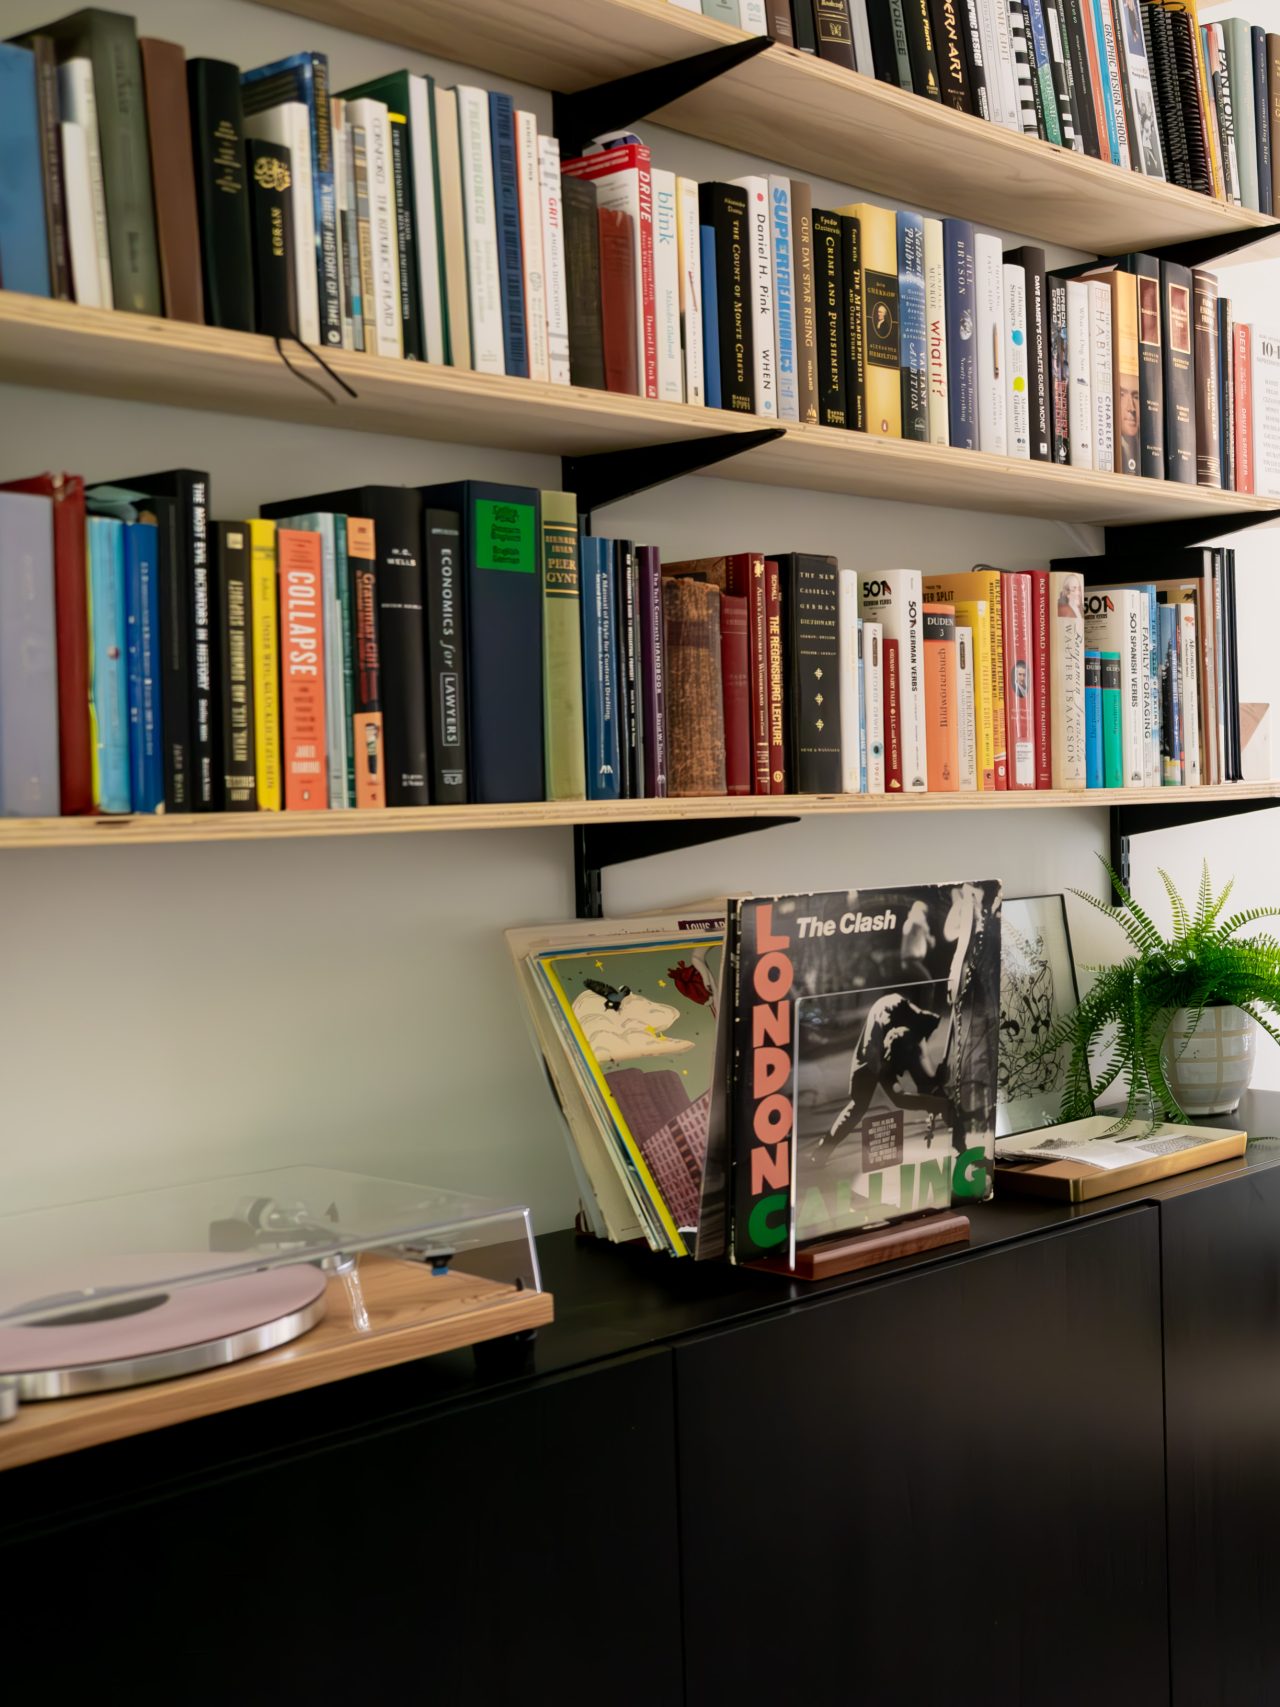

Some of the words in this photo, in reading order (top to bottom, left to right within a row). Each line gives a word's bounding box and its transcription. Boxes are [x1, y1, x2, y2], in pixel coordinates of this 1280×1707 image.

[922, 19, 932, 51] Plants
[970, 30, 983, 67] DESIGN
[1103, 23, 1117, 67] GRAPHIC
[948, 43, 962, 83] ART
[1110, 71, 1122, 107] DESIGN
[1217, 49, 1236, 147] PANTONE
[1115, 109, 1127, 147] SCHOOL
[322, 195, 336, 228] BRIEF
[547, 196, 559, 229] GRIT
[639, 170, 652, 223] DRIVE
[270, 207, 284, 256] KORAN
[657, 191, 674, 246] blink
[732, 220, 741, 240] THE
[756, 213, 768, 260] Daniel
[800, 216, 810, 243] OUR
[324, 230, 339, 280] HISTORY
[732, 243, 743, 281] COUNT
[758, 265, 769, 279] H.
[801, 247, 811, 269] DAY
[825, 236, 836, 279] CRIME
[956, 240, 967, 296] BRYSON
[965, 254, 974, 286] BILL
[327, 283, 338, 296] OF
[773, 187, 793, 373] SUPERFREAKONOMICS
[802, 273, 813, 303] STAR
[827, 281, 837, 306] AND
[853, 268, 862, 290] THE
[1034, 274, 1042, 296] DAVE
[327, 299, 340, 325] TIME
[759, 285, 770, 315] Pink
[645, 315, 655, 345] Daniel
[733, 301, 744, 340] MONTE
[803, 307, 814, 348] RISING
[854, 293, 864, 383] METAMORPHOSIS
[827, 311, 840, 392] PUNISHMENT
[929, 319, 944, 368] what
[1036, 334, 1044, 373] COMPLETE
[1094, 309, 1107, 369] HABIT
[647, 360, 656, 381] Pink
[735, 343, 745, 382] CRISTO
[761, 349, 772, 390] WHEN
[908, 342, 920, 411] AMBITION
[931, 372, 945, 398] if?
[1037, 374, 1045, 397] GUIDE
[1039, 406, 1047, 434] MONEY
[1096, 395, 1105, 446] DUHIGG
[1104, 395, 1112, 450] CHARLES
[192, 483, 206, 504] THE
[193, 506, 207, 539] MOST
[386, 558, 416, 567] WELLS
[546, 572, 578, 585] GYNT
[548, 558, 577, 570] PEER
[194, 568, 209, 626] DICTATORS
[440, 547, 454, 636] ECONOMICS
[770, 574, 778, 602] SCHALL
[863, 580, 892, 597] 501
[936, 590, 954, 602] SPLIT
[287, 570, 318, 677] COLLAPSE
[769, 615, 780, 634] THE
[800, 618, 836, 627] DICTIONARY
[908, 599, 917, 628] 501
[927, 617, 954, 626] DUDEN
[1129, 612, 1138, 634] 501
[196, 627, 209, 641] IN
[909, 629, 917, 664] GERMAN
[1142, 627, 1150, 670] FAMILY
[196, 643, 210, 690] HISTORY
[439, 640, 456, 669] for
[654, 642, 662, 695] HANDBOOK
[769, 635, 782, 701] REGENSBURG
[1064, 624, 1073, 681] WALTER
[1130, 635, 1138, 675] SPANISH
[910, 665, 918, 692] VERBS
[1131, 677, 1139, 708] VERBS
[444, 676, 457, 743] LAWYERS
[772, 703, 783, 747] LECTURE
[965, 690, 974, 742] FEDERALIST
[1143, 674, 1151, 740] FORAGING
[1065, 689, 1075, 764] ISAACSON
[967, 744, 975, 776] PAPERS
[797, 916, 835, 939] The
[839, 909, 897, 935] Clash
[752, 904, 795, 1196] LONDON
